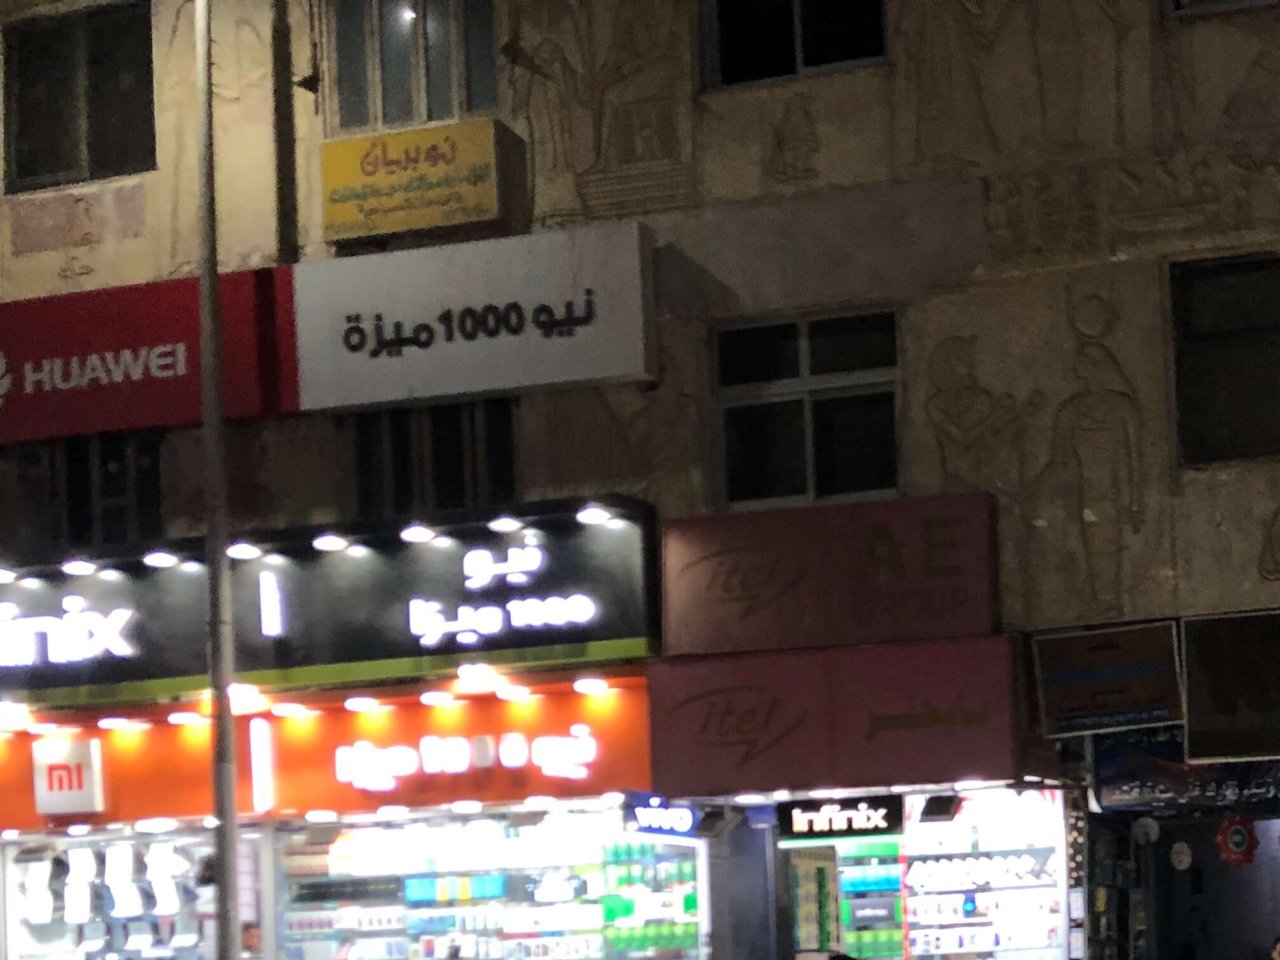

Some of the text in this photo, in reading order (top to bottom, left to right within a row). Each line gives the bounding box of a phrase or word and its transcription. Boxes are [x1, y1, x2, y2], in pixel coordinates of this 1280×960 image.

[343, 287, 596, 358] نيو 1000 ميزة
[23, 342, 187, 394] HUAWEI
